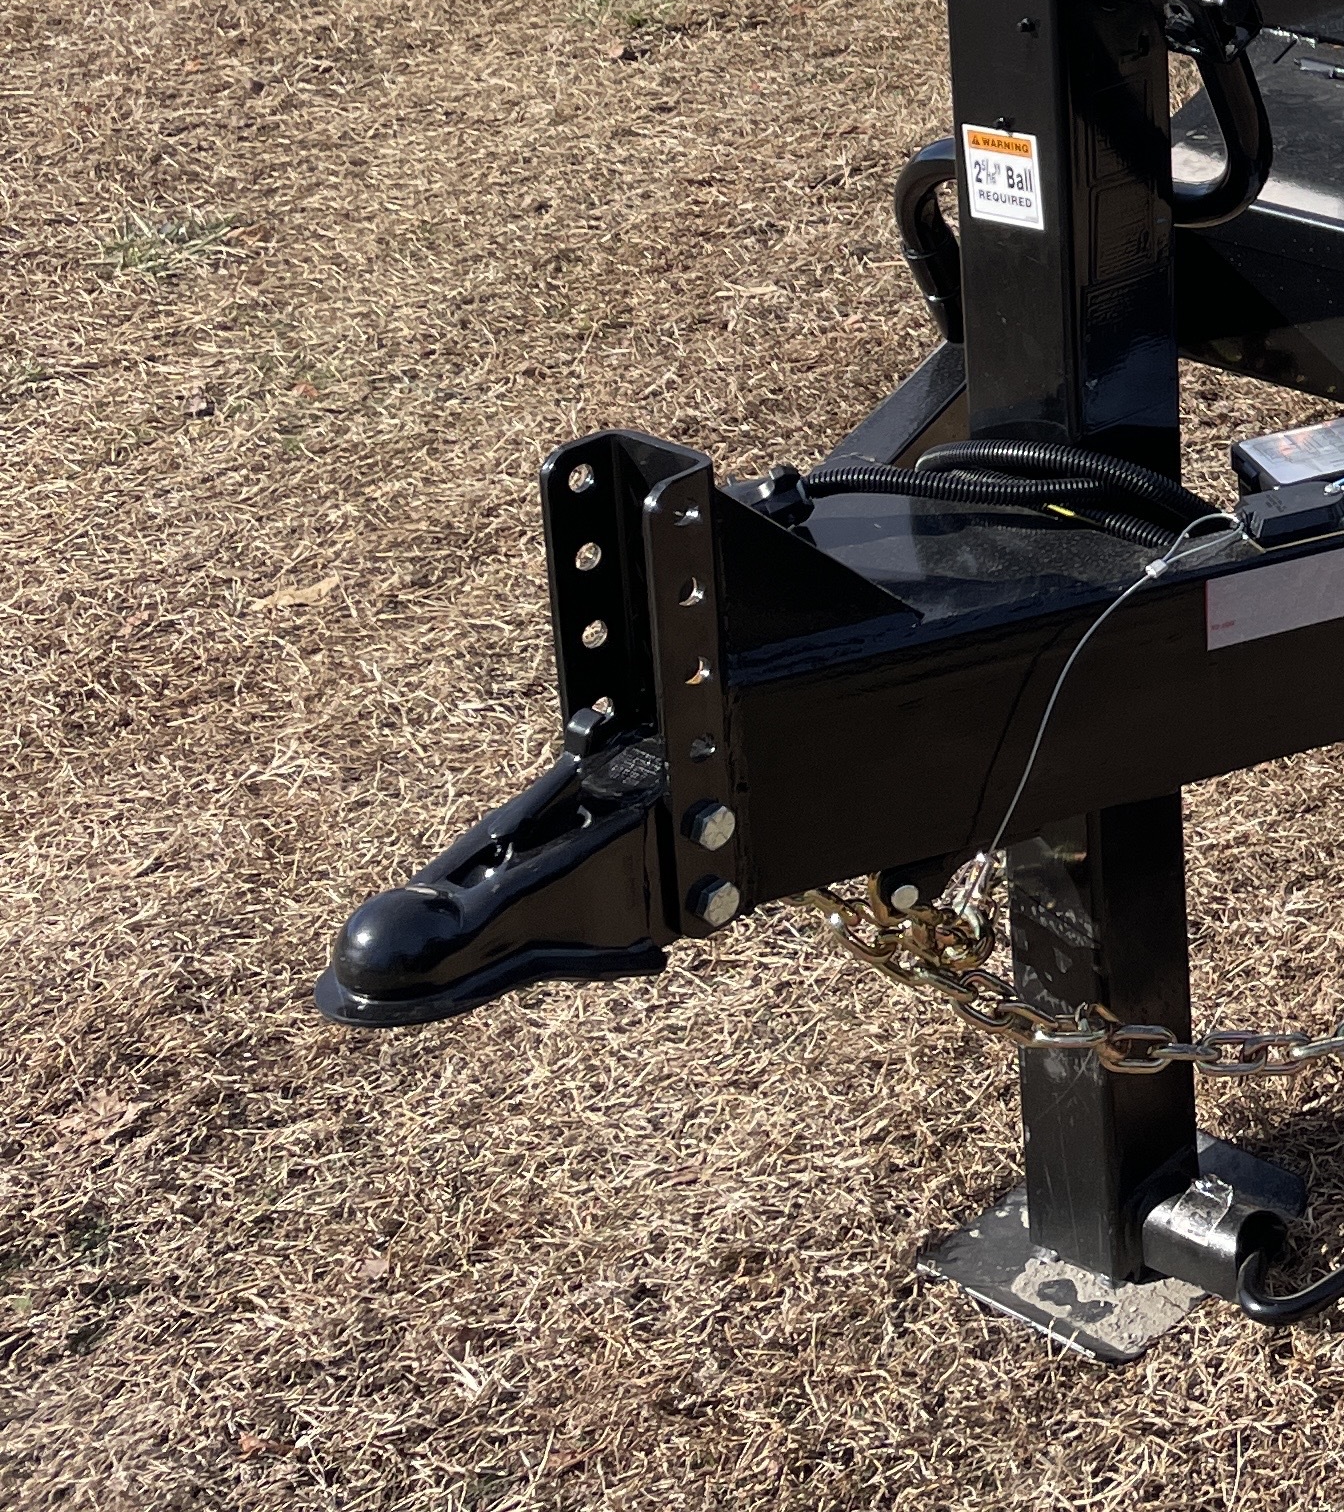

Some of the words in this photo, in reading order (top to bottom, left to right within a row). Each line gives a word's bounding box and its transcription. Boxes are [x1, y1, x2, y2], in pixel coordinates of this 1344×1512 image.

[981, 136, 1030, 154] WARNING
[1005, 164, 1034, 193] Ball
[978, 189, 1033, 209] REQUIRED
